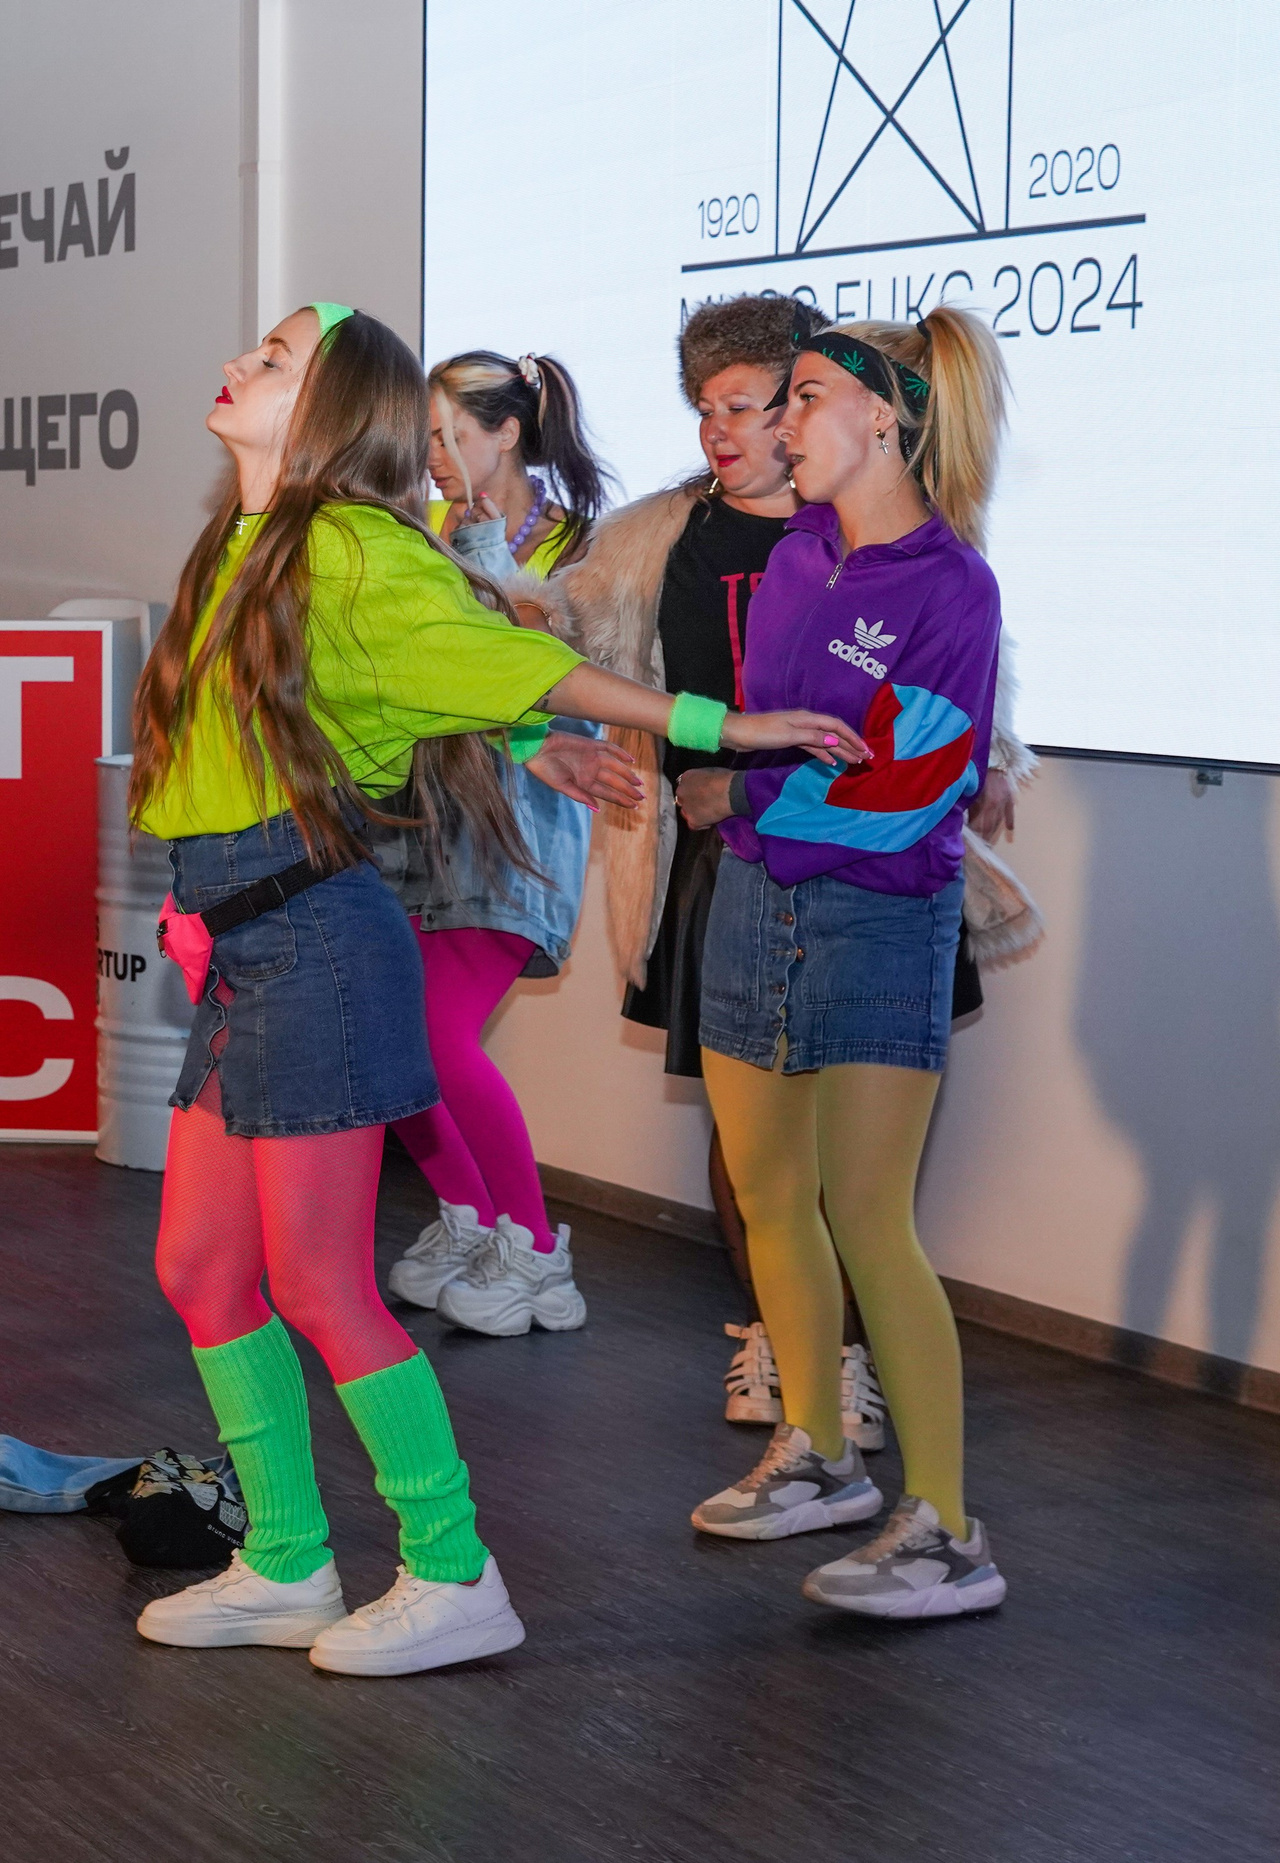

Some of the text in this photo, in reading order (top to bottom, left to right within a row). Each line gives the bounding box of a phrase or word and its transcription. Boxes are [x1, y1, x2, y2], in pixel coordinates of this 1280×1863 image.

[1029, 143, 1121, 199] 2020
[697, 193, 760, 239] 1920
[993, 253, 1143, 338] 2024
[828, 639, 888, 680] adidas
